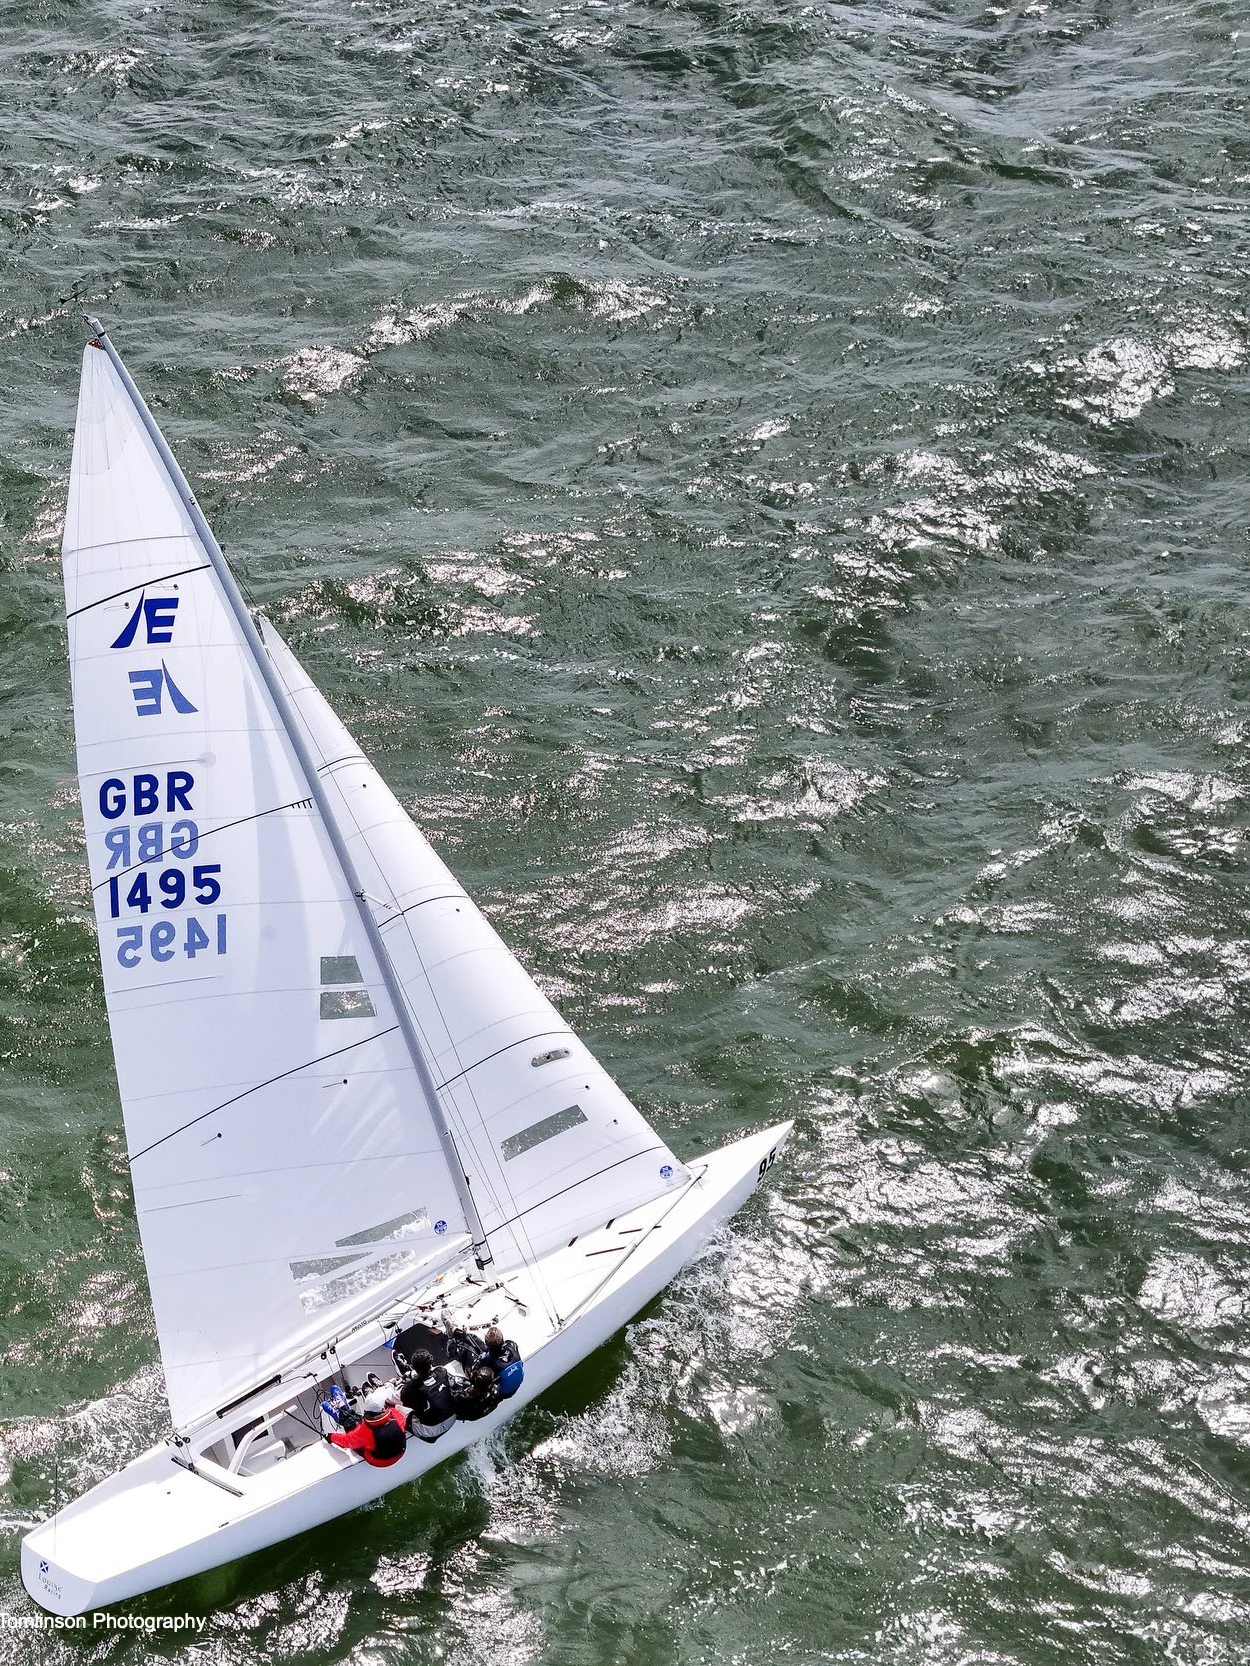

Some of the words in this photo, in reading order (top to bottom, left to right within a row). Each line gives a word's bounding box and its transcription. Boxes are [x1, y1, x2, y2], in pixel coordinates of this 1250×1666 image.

[99, 771, 195, 820] GBR
[109, 864, 222, 918] 1495
[757, 1146, 777, 1183] 95
